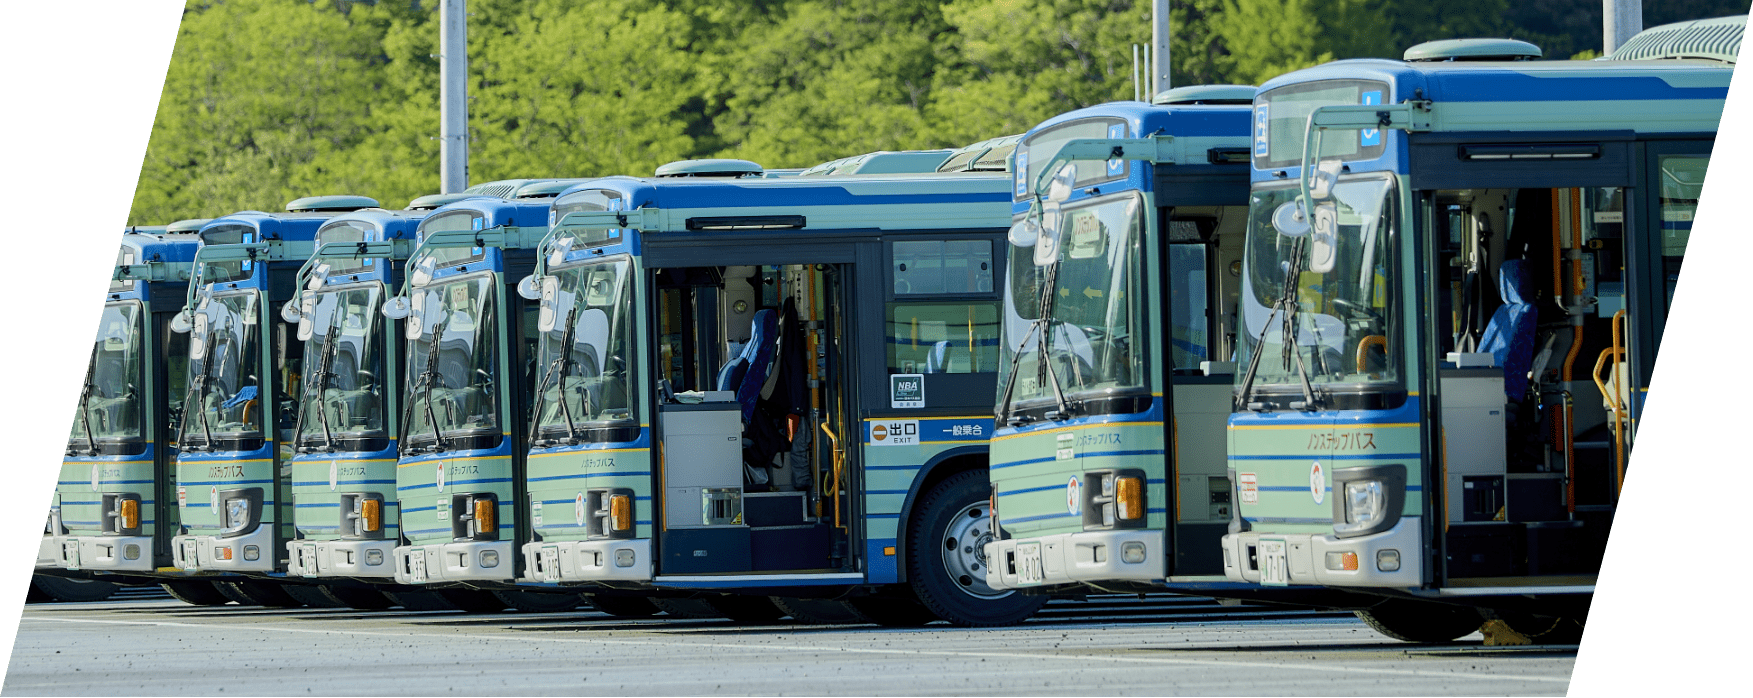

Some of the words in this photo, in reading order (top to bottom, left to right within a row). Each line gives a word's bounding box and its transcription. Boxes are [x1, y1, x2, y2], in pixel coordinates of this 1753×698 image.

[897, 381, 918, 391] NBA
[890, 423, 916, 436] 出口
[942, 424, 983, 436] 一般乗合
[1075, 432, 1121, 447] ノンステップバス
[1307, 432, 1377, 450] ノンステップバス
